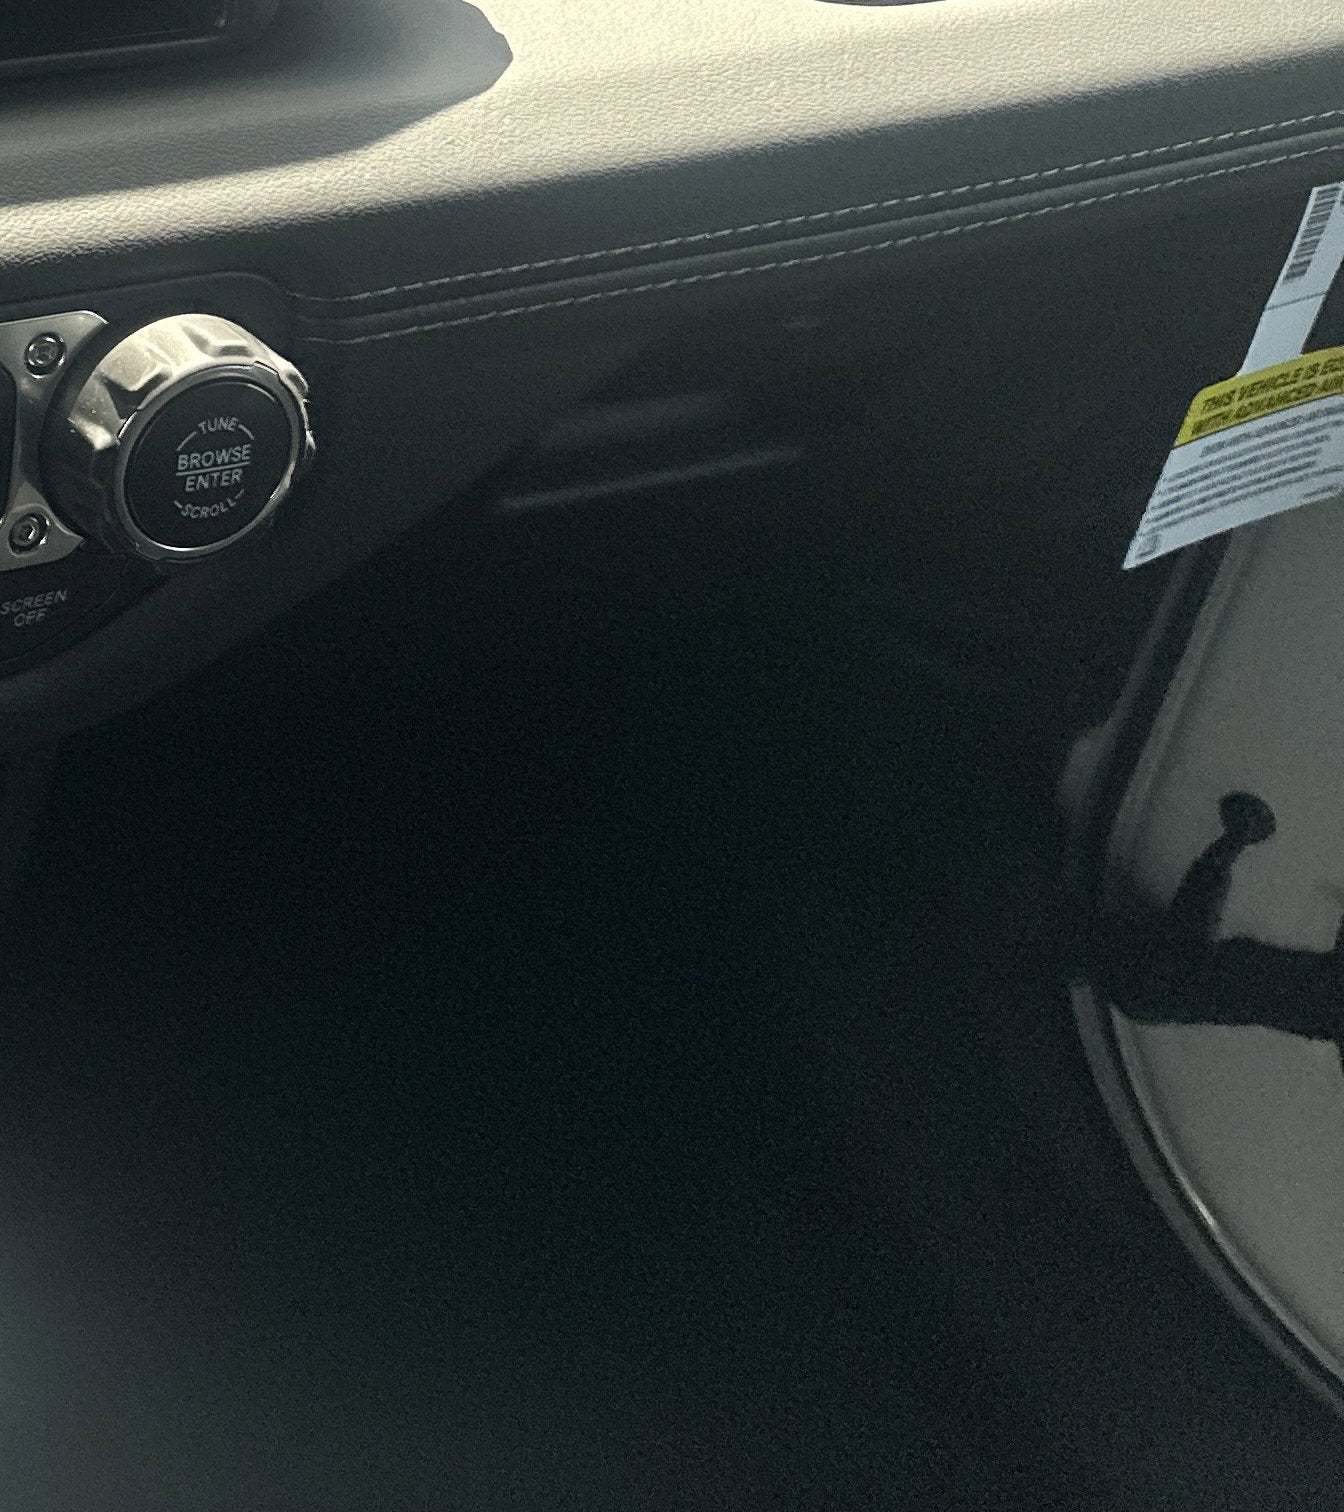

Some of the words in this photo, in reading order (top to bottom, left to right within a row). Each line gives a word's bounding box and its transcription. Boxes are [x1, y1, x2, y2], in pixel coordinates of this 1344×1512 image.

[197, 415, 240, 435] TUNE
[177, 443, 252, 471] BROWSE
[185, 468, 244, 493] ENTER
[179, 497, 237, 519] SCROLL
[0, 589, 68, 616] SCREEN
[13, 607, 47, 628] OFF
